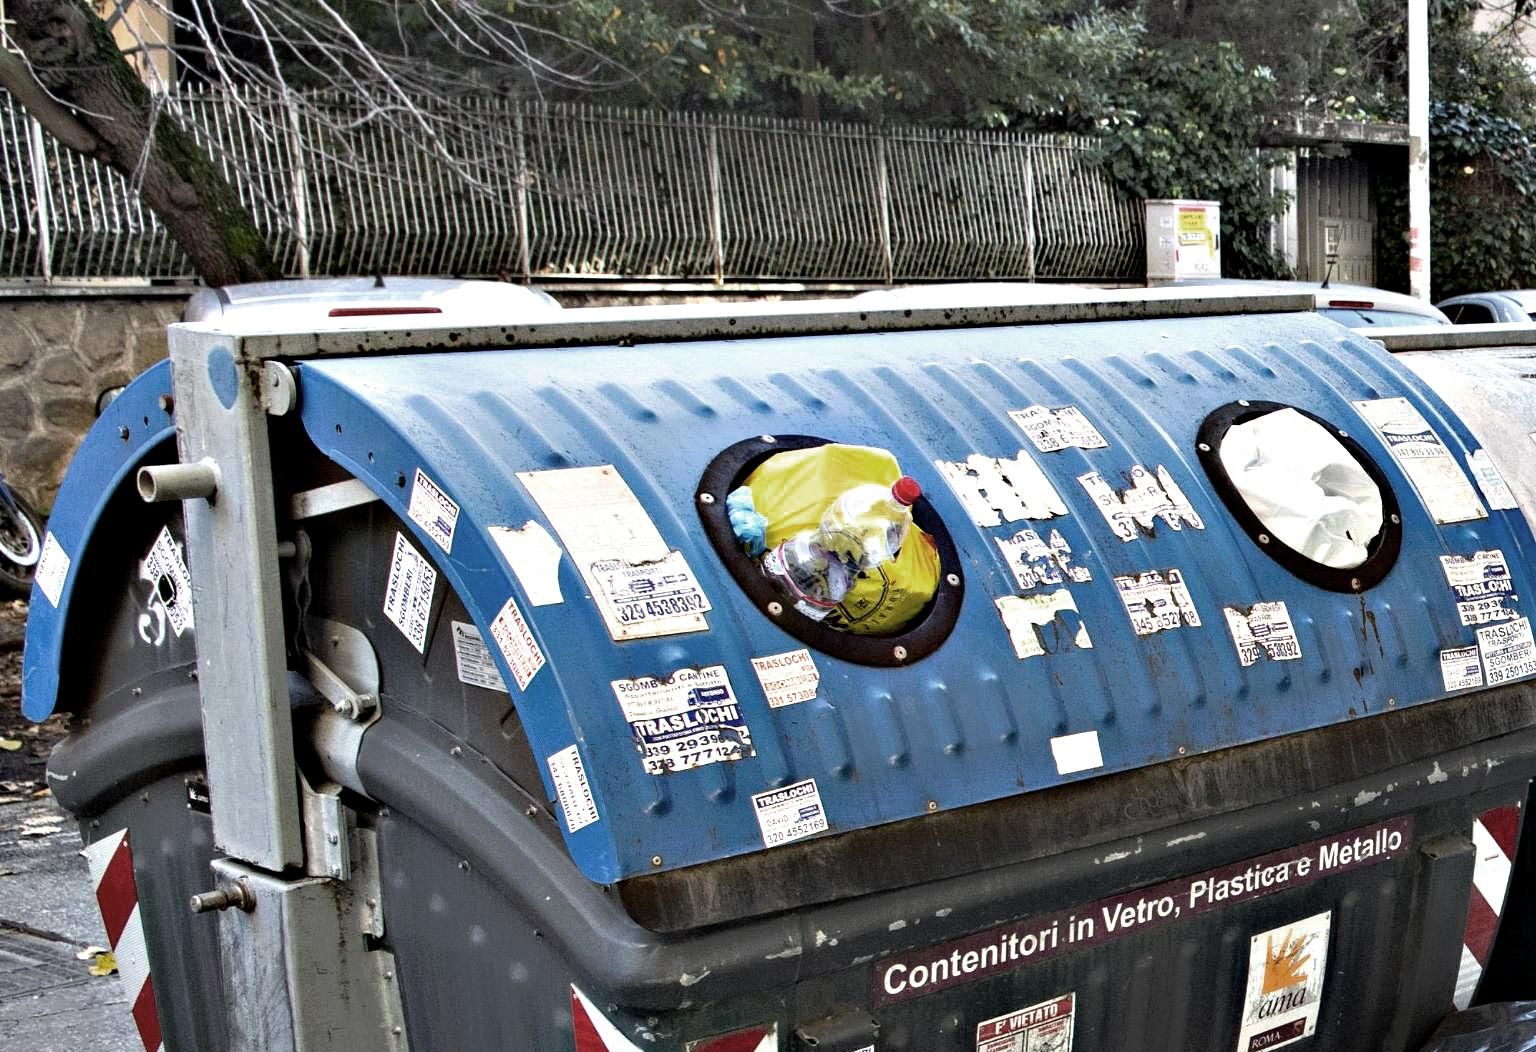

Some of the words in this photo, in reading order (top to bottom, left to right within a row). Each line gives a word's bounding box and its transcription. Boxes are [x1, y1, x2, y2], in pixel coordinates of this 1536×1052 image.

[163, 529, 192, 589] TRASLOC
[387, 537, 406, 612] TRASLOCHI
[398, 568, 414, 627] SGOMBERI
[1455, 580, 1512, 597] TRASLOCHI
[412, 620, 424, 647] 338
[418, 566, 434, 621] 6715053
[616, 603, 645, 622] 329
[646, 594, 706, 617] 4538392
[508, 602, 543, 666] TRASLOCHI
[1133, 618, 1154, 632] 345
[1479, 619, 1529, 641] TRASLOCHI
[754, 652, 810, 671] TRASLOCHI
[1442, 648, 1478, 661] TRASLOCHI
[1489, 650, 1532, 668] SGOMBERI
[679, 669, 721, 682] CANTINE
[1489, 670, 1504, 684] 339
[786, 688, 816, 703] 57308
[632, 704, 739, 737] TRASLOCHI
[571, 750, 598, 819] TRASLOCHI
[757, 783, 813, 807] TRASLOCHI
[767, 831, 784, 844] 320
[786, 818, 825, 837] 4552169
[884, 920, 1059, 996] Contenitori
[1068, 914, 1094, 943] in
[1102, 892, 1182, 933] Vetro,
[1189, 860, 1290, 909] Plastica
[1296, 855, 1312, 877] e
[1318, 828, 1402, 871] Metallo
[1258, 986, 1307, 1019] ama
[1010, 1003, 1059, 1031] VIETATO
[1251, 1031, 1281, 1049] ROMA
